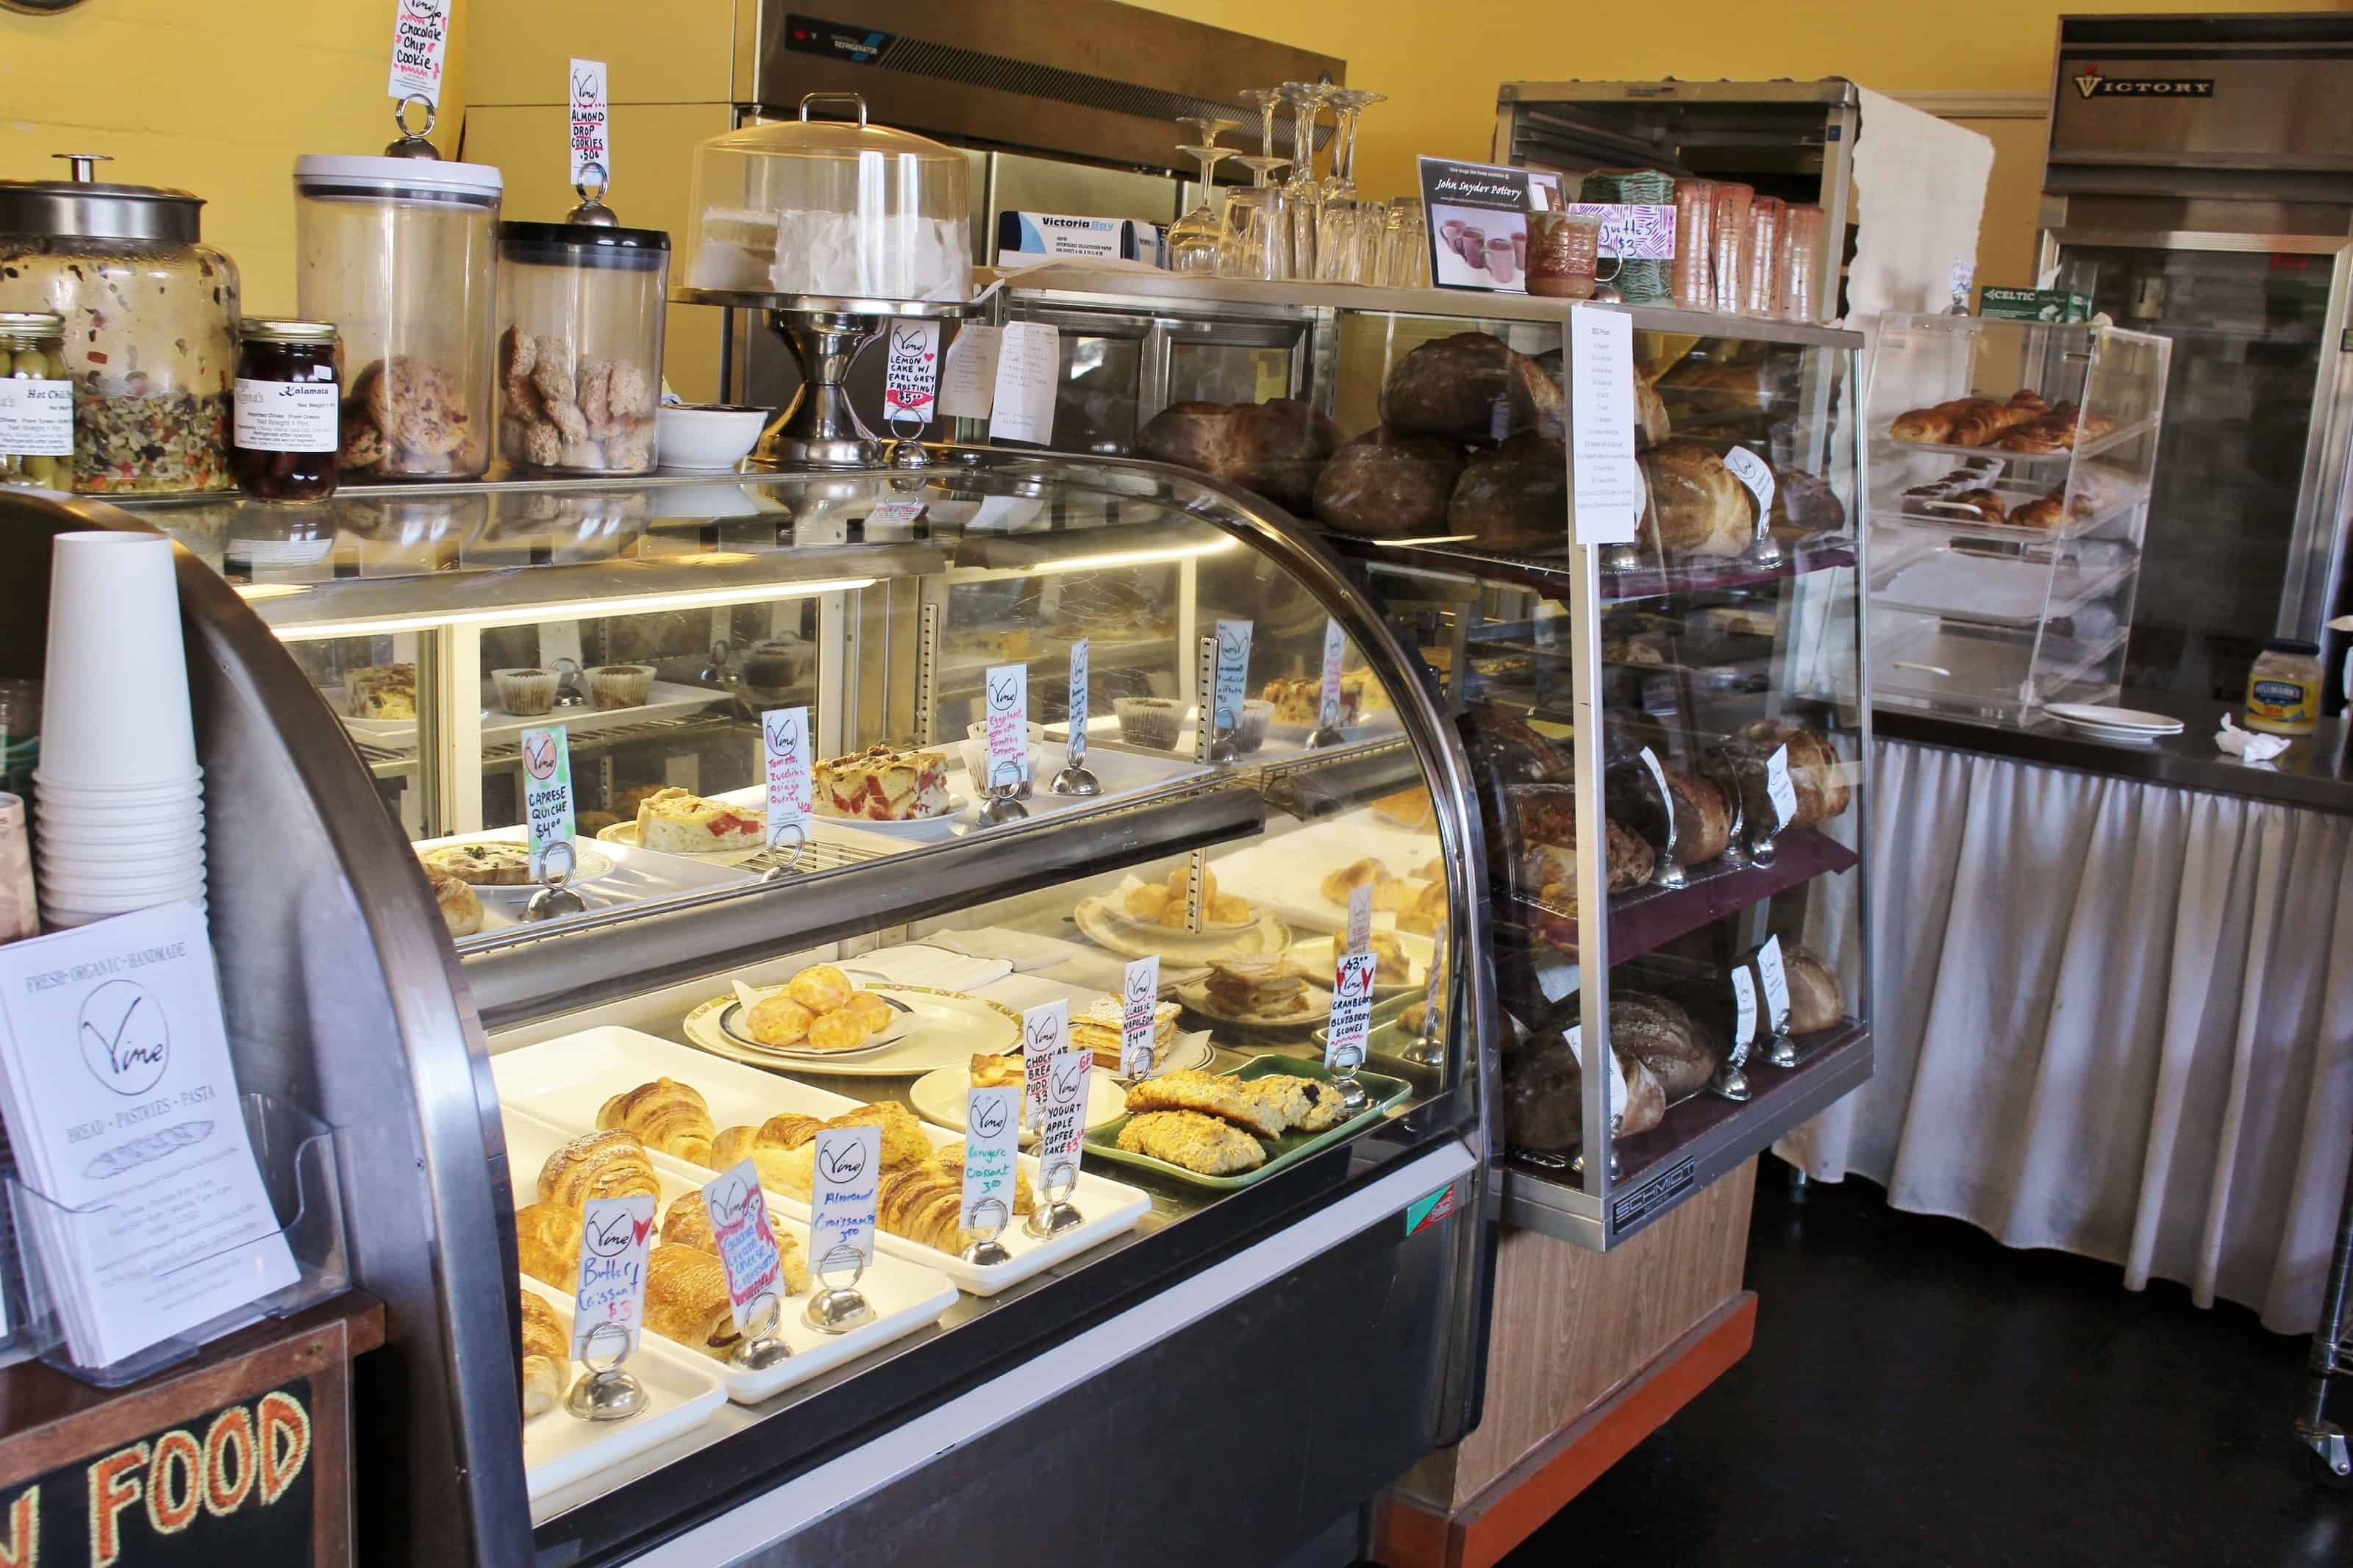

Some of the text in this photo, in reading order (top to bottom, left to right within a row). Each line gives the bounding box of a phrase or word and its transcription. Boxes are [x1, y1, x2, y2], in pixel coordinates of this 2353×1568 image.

[400, 22, 442, 41] Chocolate
[404, 36, 426, 54] Chip
[397, 49, 432, 70] Cookie
[2074, 76, 2210, 97] VICTORY
[571, 110, 605, 122] ALMOND
[574, 125, 595, 137] DROP
[571, 138, 604, 148] COOKIES
[1435, 177, 1522, 201] John Snyder Pottery
[1043, 217, 1114, 231] Victoria Bay
[1618, 237, 1637, 257] $3
[1994, 290, 2035, 301] CELTIC
[890, 356, 921, 365] LEMON
[890, 365, 913, 373] CAKE
[888, 373, 935, 383] EARL GREY
[279, 386, 329, 397] Kalamata
[890, 382, 935, 394] FROSTING!
[529, 786, 565, 807] CAPRESE
[532, 801, 568, 820] QUICHE
[1124, 1002, 1151, 1018] CLASSIC
[1332, 995, 1373, 1011] CRANBERRY
[1123, 1014, 1154, 1031] NAPOLEON
[1330, 1012, 1370, 1028] BLUEBERRY
[82, 995, 164, 1075] Vine
[1029, 1016, 1054, 1045] Vine
[1335, 1023, 1363, 1037] SCONES
[1079, 1053, 1091, 1069] GF
[1028, 1064, 1051, 1080] BREA
[1054, 1065, 1076, 1095] Vine
[1026, 1078, 1048, 1097] PUDD
[67, 1084, 217, 1144] BREAD PASTRIES PASTA
[973, 1100, 1004, 1128] Vine
[1048, 1103, 1082, 1119] YOGURT
[1046, 1117, 1074, 1134] APPLE
[1044, 1128, 1074, 1147] COFFEE
[823, 1142, 861, 1174] Vine
[1044, 1142, 1066, 1156] CAKE
[824, 1187, 874, 1206] Almond
[1615, 1164, 1694, 1220] SCHMIDT
[589, 1214, 629, 1247] Vine
[584, 1257, 632, 1286] Butter
[607, 1300, 632, 1322] $3
[87, 1390, 312, 1568] FOOD
